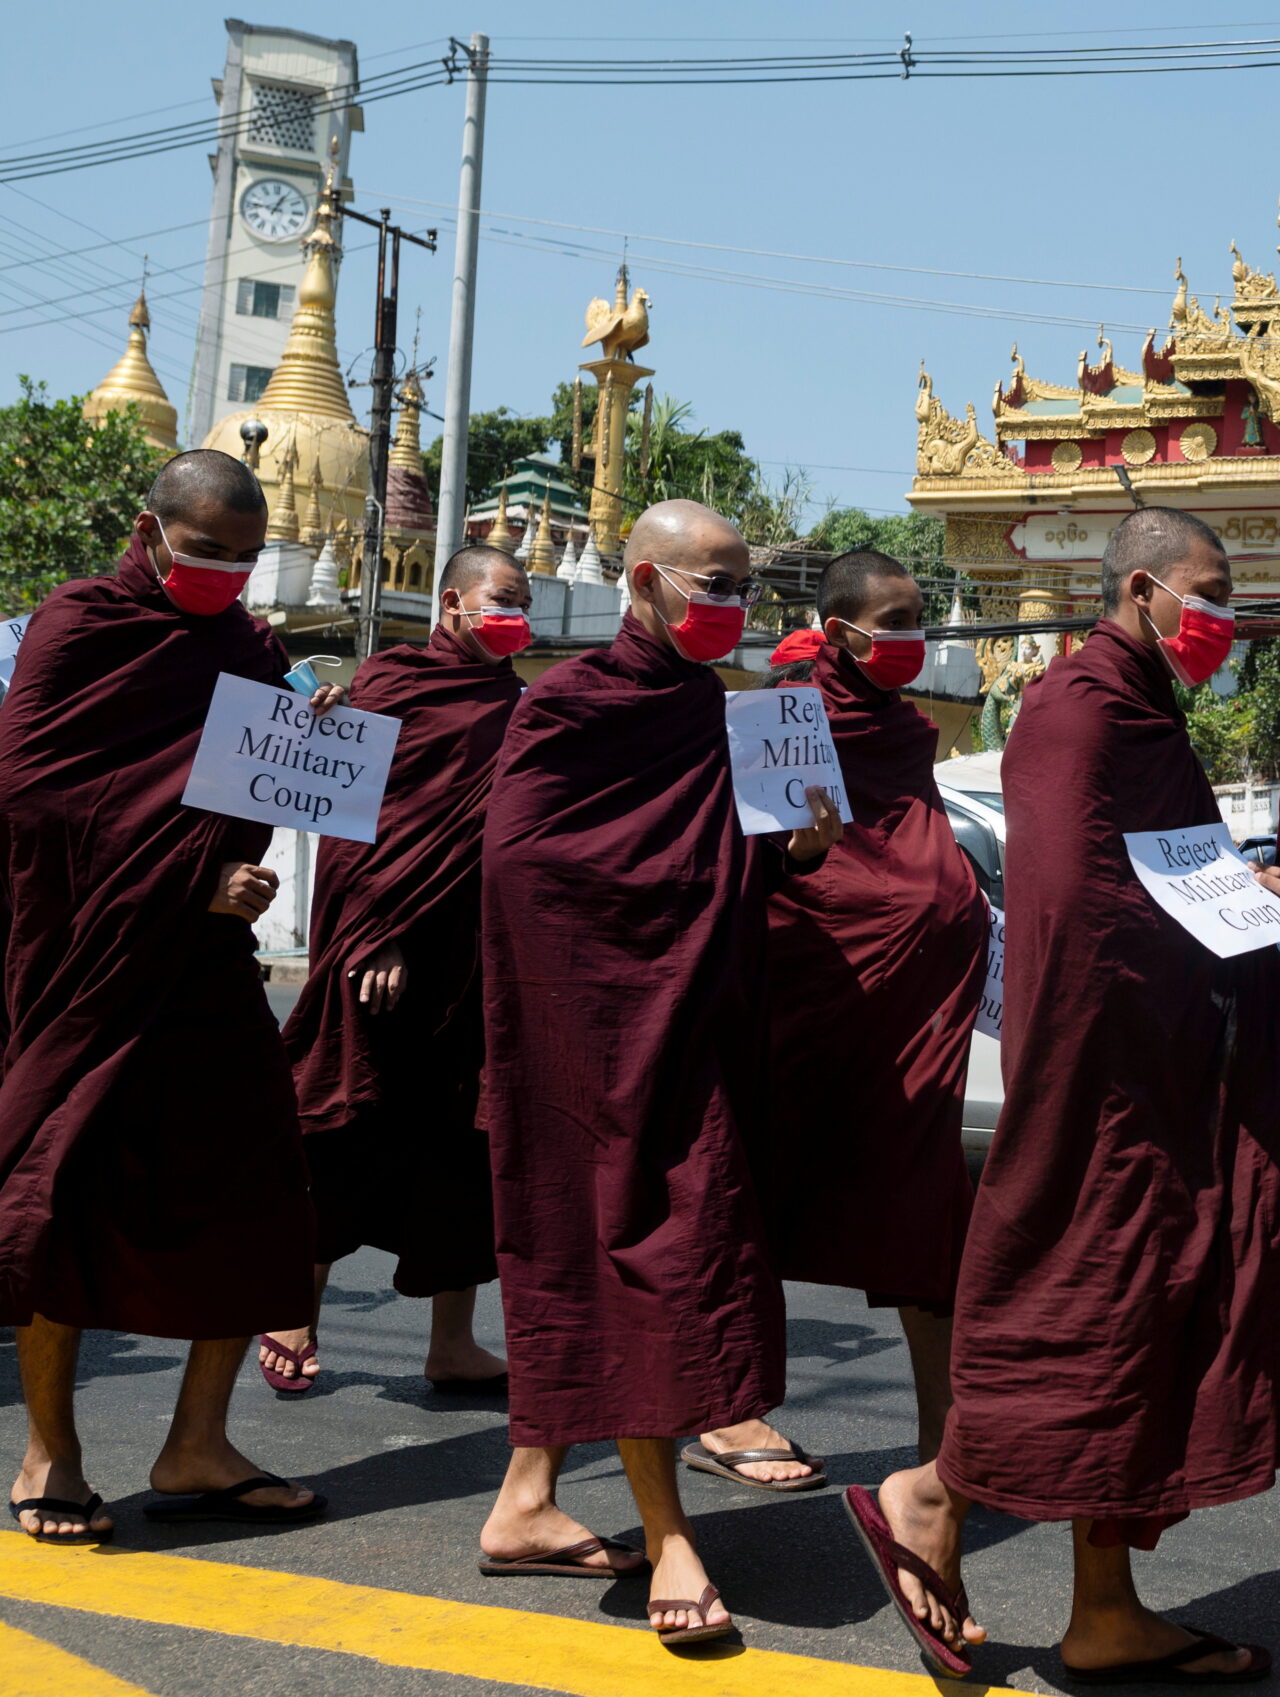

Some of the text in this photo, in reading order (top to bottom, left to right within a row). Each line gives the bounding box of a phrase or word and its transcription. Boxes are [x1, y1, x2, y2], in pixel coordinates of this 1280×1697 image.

[268, 693, 368, 743] Reject
[236, 726, 366, 788] Military
[249, 773, 333, 823] Coup
[1157, 835, 1225, 870] Reject
